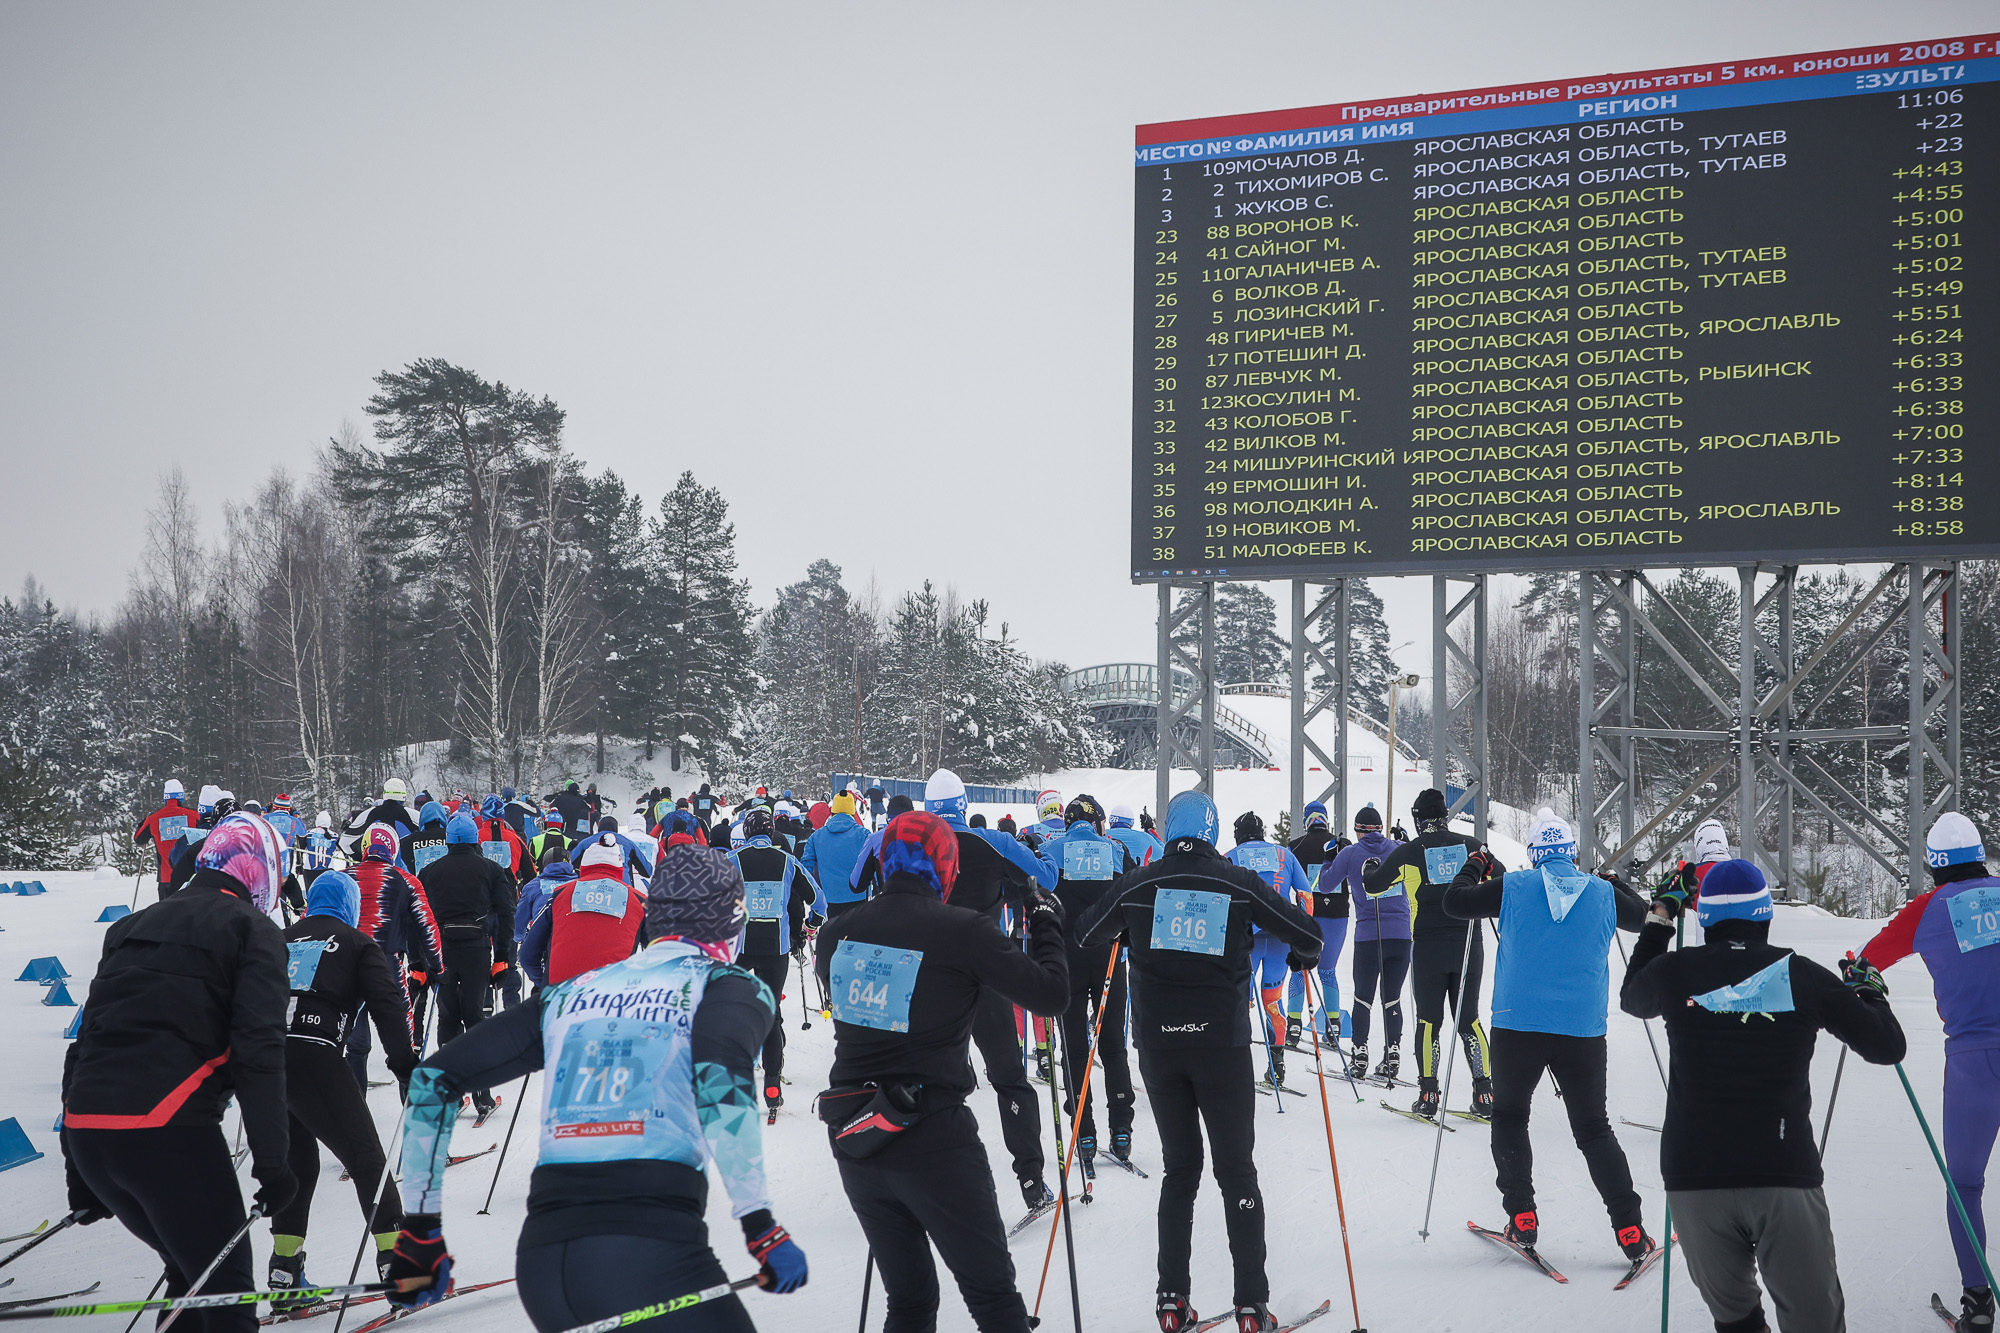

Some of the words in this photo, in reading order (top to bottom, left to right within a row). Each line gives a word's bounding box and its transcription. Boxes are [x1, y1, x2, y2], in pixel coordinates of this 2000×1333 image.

[1341, 87, 1560, 121] Предварительные
[1567, 71, 1712, 99] результаты
[1721, 65, 1735, 80] 5
[1744, 64, 1784, 78] км.
[1793, 52, 1889, 72] юноши
[1899, 41, 1964, 61] 2008
[1134, 143, 1203, 161] МЕСТО
[1207, 140, 1231, 155] №
[1235, 127, 1353, 151] ФАМИЛИЯ
[1362, 121, 1413, 139] ИМЯ
[1579, 94, 1677, 117] РЕГИОН
[1163, 167, 1172, 181] 1
[1343, 148, 1365, 165] Д.
[1413, 127, 1569, 156] ЯРОСЛАВСКАЯ
[1578, 117, 1684, 139] ОБЛАСТЬ
[1898, 88, 1963, 109] 11:06
[1161, 188, 1172, 201] 2
[1213, 183, 1224, 197] 2
[1234, 170, 1362, 194] ТИХОМИРОВ
[1369, 168, 1388, 182] С.
[1413, 150, 1569, 178] ЯРОСЛАВСКАЯ
[1578, 140, 1690, 162] ОБЛАСТЬ,
[1698, 130, 1787, 150] ТУТАЕВ
[1916, 113, 1963, 129] +22
[1161, 209, 1172, 222] 3
[1214, 204, 1223, 218] 1
[1234, 197, 1308, 216] ЖУКОВ
[1314, 195, 1333, 208] С.
[1413, 172, 1569, 200] ЯРОСЛАВСКАЯ
[1578, 162, 1690, 184] ОБЛАСТЬ,
[1698, 153, 1787, 174] ТУТАЕВ
[1916, 136, 1962, 153] +23
[1155, 229, 1177, 244] 23
[1206, 225, 1230, 240] 88
[1235, 216, 1333, 237] ВОРОНОВ
[1341, 214, 1359, 228] К.
[1413, 195, 1569, 222] ЯРОСЛАВСКАЯ
[1578, 185, 1684, 207] ОБЛАСТЬ
[1892, 160, 1962, 179] +4:43
[1155, 271, 1177, 286] 25
[1361, 256, 1380, 270] А.
[1412, 240, 1569, 266] ЯРОСЛАВСКАЯ
[1577, 231, 1683, 252] ОБЛАСТЬ
[1892, 208, 1963, 226] +5:00
[1155, 292, 1177, 307] 26
[1212, 289, 1223, 303] 6
[1235, 282, 1318, 301] ВОЛКОВ
[1324, 280, 1345, 297] Д.
[1412, 262, 1569, 288] ЯРОСЛАВСКАЯ
[1577, 254, 1689, 275] ОБЛАСТЬ,
[1698, 246, 1787, 265] ТУТАЕВ
[1892, 232, 1962, 250] +5:01
[1154, 314, 1177, 328] 27
[1212, 310, 1223, 324] 5
[1233, 297, 1360, 323] ЛОЗИНСКИЙ
[1368, 299, 1384, 313] Г.
[1412, 285, 1568, 310] ЯРОСЛАВСКАЯ
[1577, 277, 1689, 297] ОБЛАСТЬ,
[1698, 269, 1787, 288] ТУТАЕВ
[1892, 256, 1963, 274] +5:02
[1154, 356, 1176, 370] 29
[1207, 353, 1229, 367] 17
[1234, 345, 1338, 365] ПОТЕШИН
[1345, 344, 1366, 361] Д.
[1411, 330, 1568, 354] ЯРОСЛАВСКАЯ
[1577, 323, 1689, 343] ОБЛАСТЬ,
[1698, 312, 1840, 335] ЯРОСЛАВЛЬ
[1892, 304, 1962, 321] +5:51
[1154, 377, 1176, 391] 30
[1205, 374, 1229, 388] 87
[1233, 369, 1312, 387] ЛЕВЧУК
[1320, 367, 1341, 381] М.
[1411, 352, 1568, 376] ЯРОСЛАВСКАЯ
[1577, 346, 1683, 365] ОБЛАСТЬ
[1892, 328, 1963, 345] +6:24
[1153, 398, 1175, 412] 31
[1339, 388, 1360, 402] М.
[1411, 375, 1568, 398] ЯРОСЛАВСКАЯ
[1576, 369, 1689, 388] ОБЛАСТЬ,
[1699, 361, 1811, 381] РЫБИНСК
[1892, 352, 1962, 369] +6:33
[1153, 462, 1176, 476] 34
[1204, 459, 1228, 473] 24
[1233, 448, 1394, 472] МИШУРИНСКИЙ
[1411, 443, 1567, 464] ЯРОСЛАВСКАЯ
[1576, 438, 1689, 456] ОБЛАСТЬ,
[1698, 430, 1840, 450] ЯРОСЛАВЛЬ
[1892, 424, 1963, 440] +7:00
[1152, 526, 1175, 539] 37
[1205, 524, 1227, 538] 19
[1233, 520, 1331, 536] НОВИКОВ
[1339, 519, 1360, 532] М.
[1410, 511, 1567, 530] ЯРОСЛАВСКАЯ
[1576, 507, 1689, 524] ОБЛАСТЬ,
[1698, 501, 1840, 519] ЯРОСЛАВЛЬ
[1892, 496, 1963, 512] +8:38
[1152, 547, 1175, 561] 38
[1204, 545, 1226, 559] 51
[1232, 541, 1346, 558] МАЛОФЕЕВ
[1354, 540, 1372, 554] К.
[1410, 533, 1567, 552] ЯРОСЛАВСКАЯ
[1576, 530, 1683, 546] ОБЛАСТЬ
[1892, 520, 1963, 536] +8:58
[166, 825, 180, 835] 617
[412, 838, 448, 850] RUSSI
[487, 853, 504, 863] 607
[1076, 857, 1101, 871] 715
[1249, 857, 1269, 869] 658
[1438, 862, 1459, 875] 657
[585, 891, 612, 906] 691
[751, 897, 773, 911] 537
[1170, 916, 1207, 940] 616
[865, 966, 892, 977] РОССИИ
[868, 960, 893, 971] ЛЫЖНЯ
[848, 978, 889, 1010] 644
[300, 1014, 321, 1025] 150
[574, 1066, 630, 1103] 718
[579, 1125, 608, 1135] MAXI
[611, 1122, 642, 1132] LIFE
[842, 1111, 874, 1132] SALOMON
[306, 1303, 330, 1315] ATOMIC
